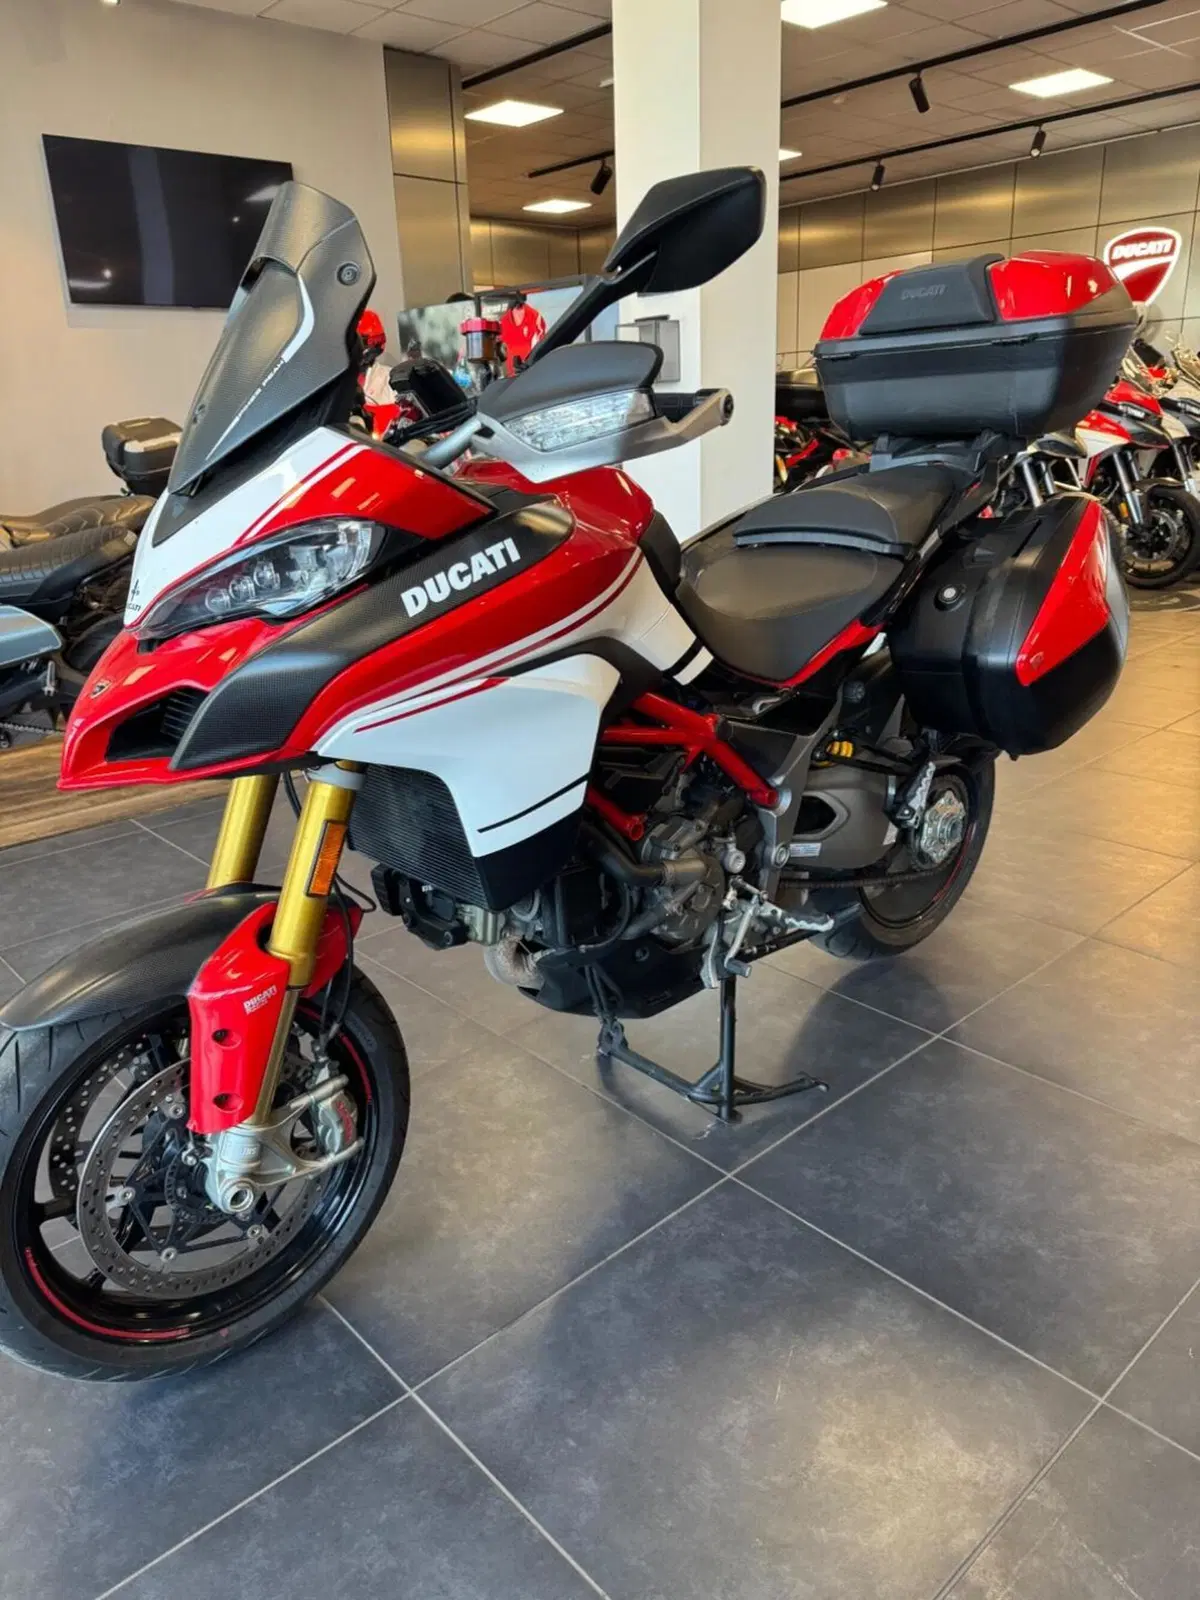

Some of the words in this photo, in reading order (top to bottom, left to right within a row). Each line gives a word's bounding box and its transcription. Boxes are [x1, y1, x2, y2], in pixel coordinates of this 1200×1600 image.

[1111, 238, 1173, 260] DUCATI
[901, 284, 946, 300] DUCATI
[400, 537, 521, 618] DUCATI
[243, 984, 277, 1010] DUCATI
